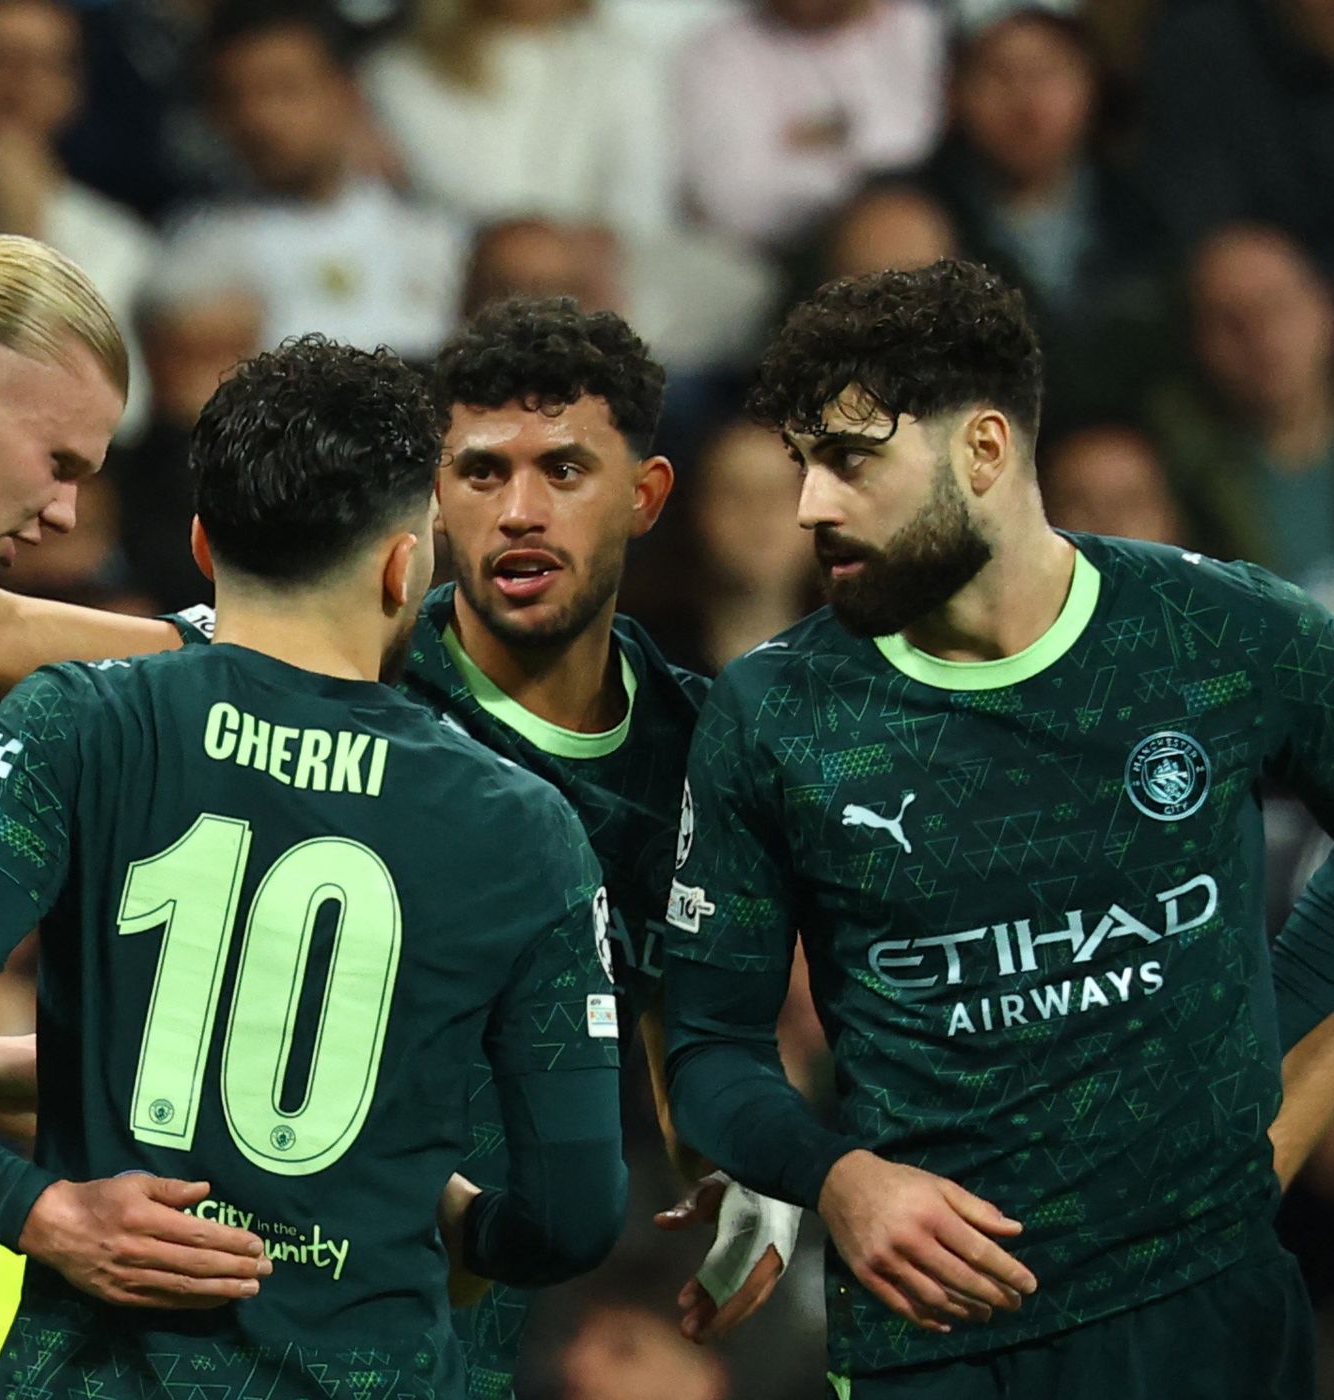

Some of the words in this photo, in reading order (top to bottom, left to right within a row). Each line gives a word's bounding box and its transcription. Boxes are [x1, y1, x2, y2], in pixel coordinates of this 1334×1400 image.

[204, 702, 389, 797] CHERKI
[868, 873, 1219, 988] ETIHAD
[117, 812, 402, 1176] 10
[946, 959, 1164, 1037] AIRWAYS
[197, 1200, 255, 1231] City
[273, 1221, 297, 1236] the
[264, 1224, 350, 1281] unity
